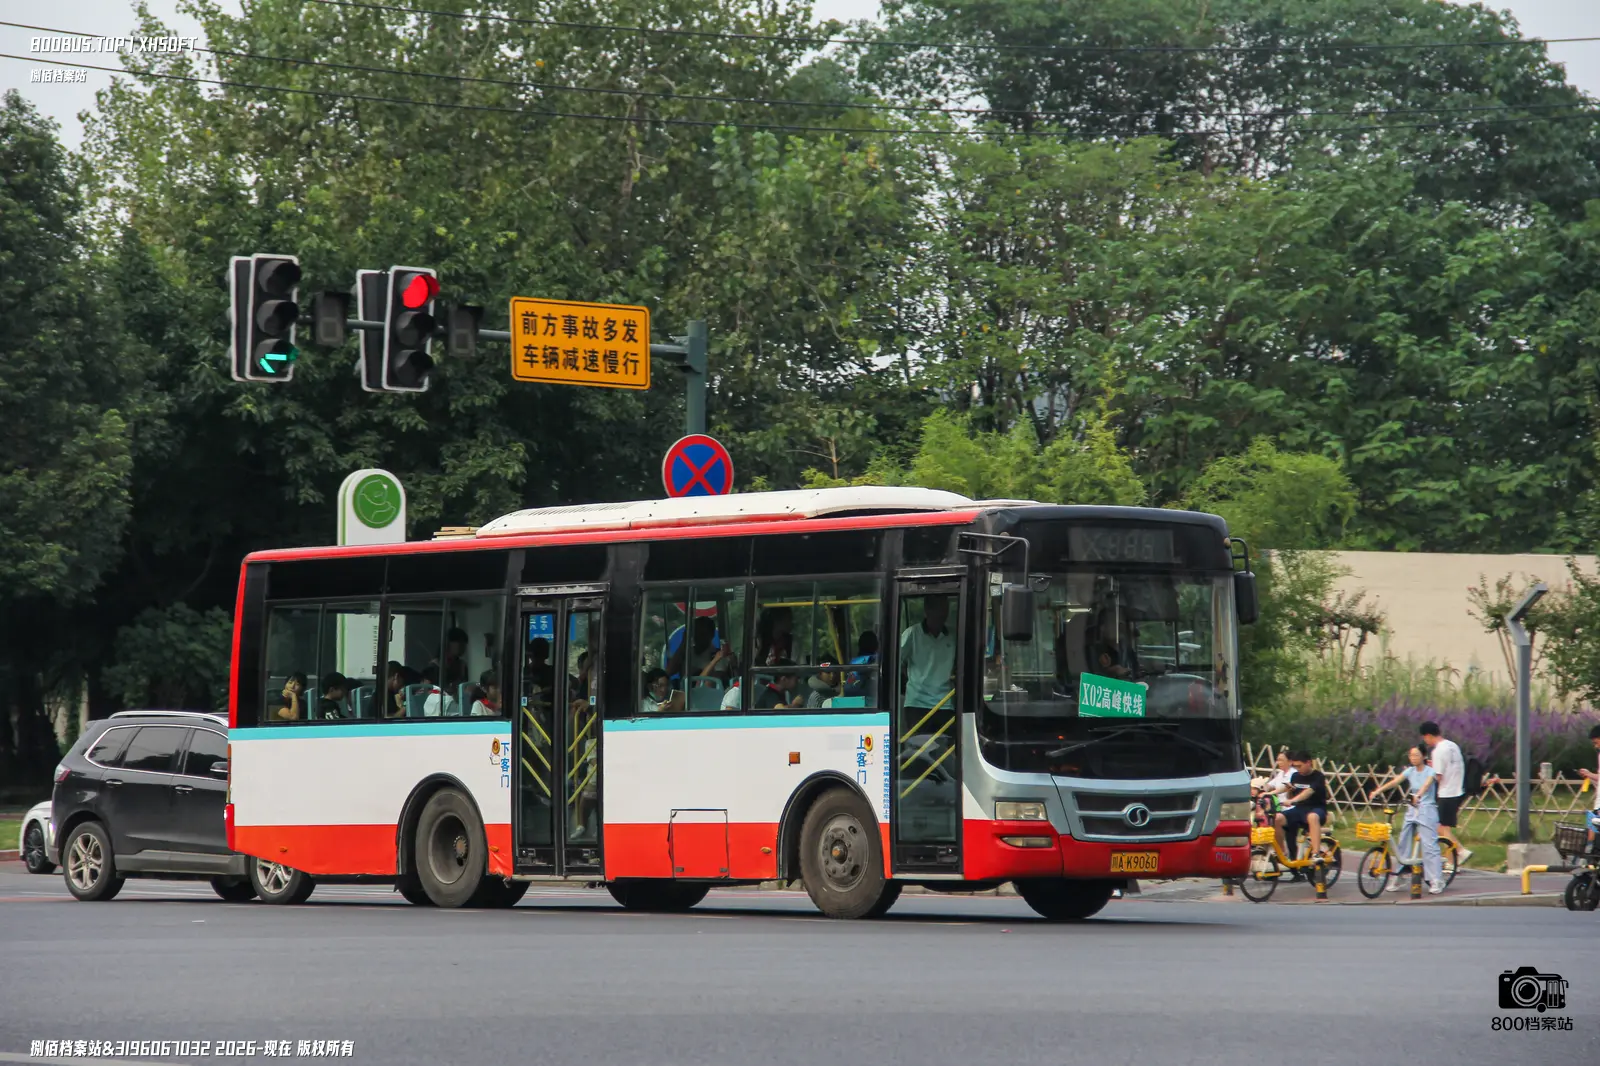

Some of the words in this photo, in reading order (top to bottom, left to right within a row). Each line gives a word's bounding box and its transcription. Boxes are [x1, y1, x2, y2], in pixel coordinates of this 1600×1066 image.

[521, 311, 639, 343] 前方事故多发
[522, 344, 640, 376] 车辆减速慢行
[1081, 682, 1143, 717] X02高峰快线
[500, 741, 511, 788] 下客门
[856, 734, 867, 785] 上客门
